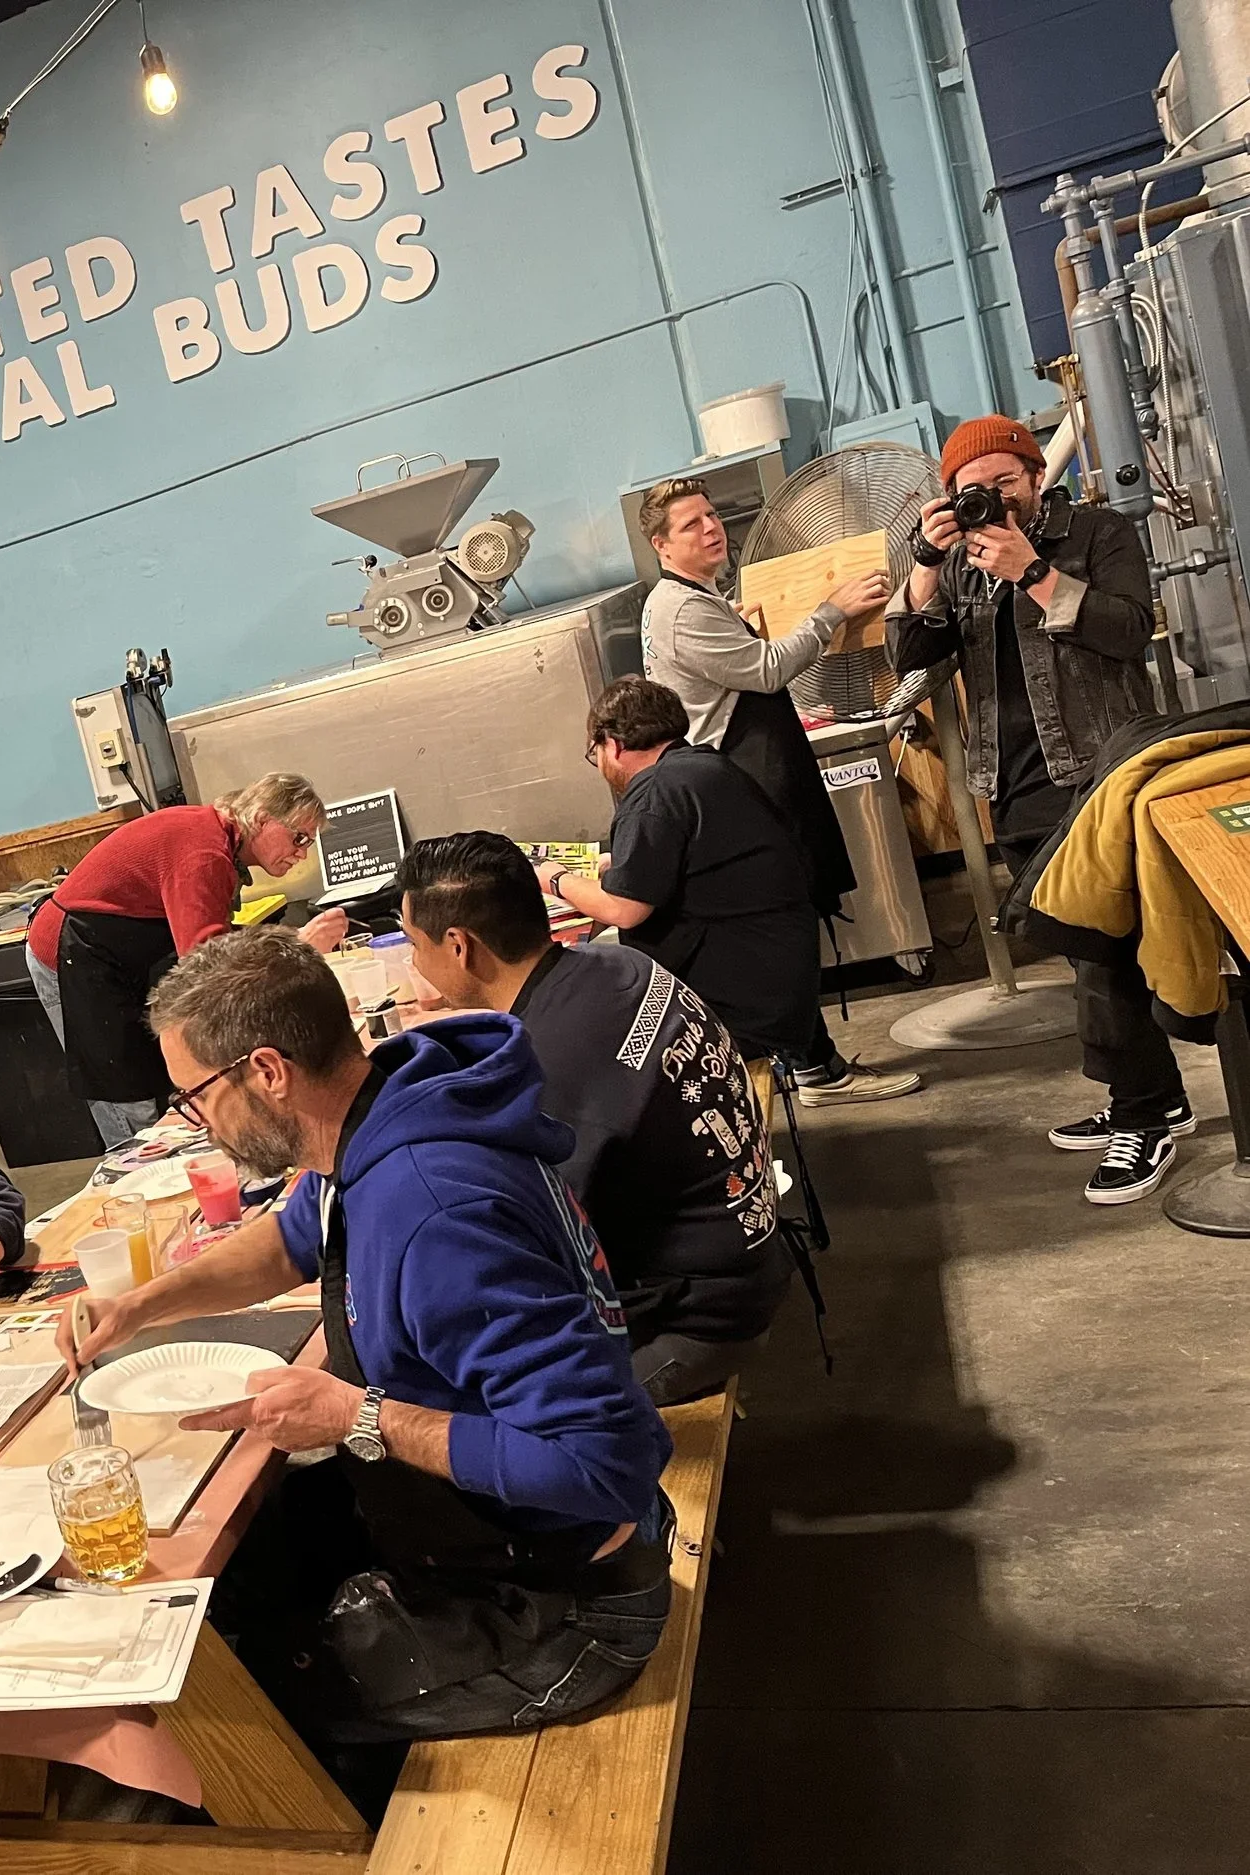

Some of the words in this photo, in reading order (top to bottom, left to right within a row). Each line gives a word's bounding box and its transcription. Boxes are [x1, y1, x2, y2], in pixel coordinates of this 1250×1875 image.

[180, 44, 600, 274] TASTES
[152, 214, 439, 384] BUDS
[823, 763, 879, 787] AVANTCO
[346, 803, 366, 815] DOPE
[328, 851, 342, 861] NOT
[347, 845, 368, 855] YOUR
[330, 853, 364, 867] AVERAGE
[331, 862, 353, 873] PAINT
[357, 857, 380, 868] NIGHT
[363, 866, 377, 876] AND
[379, 862, 396, 872] ARTS
